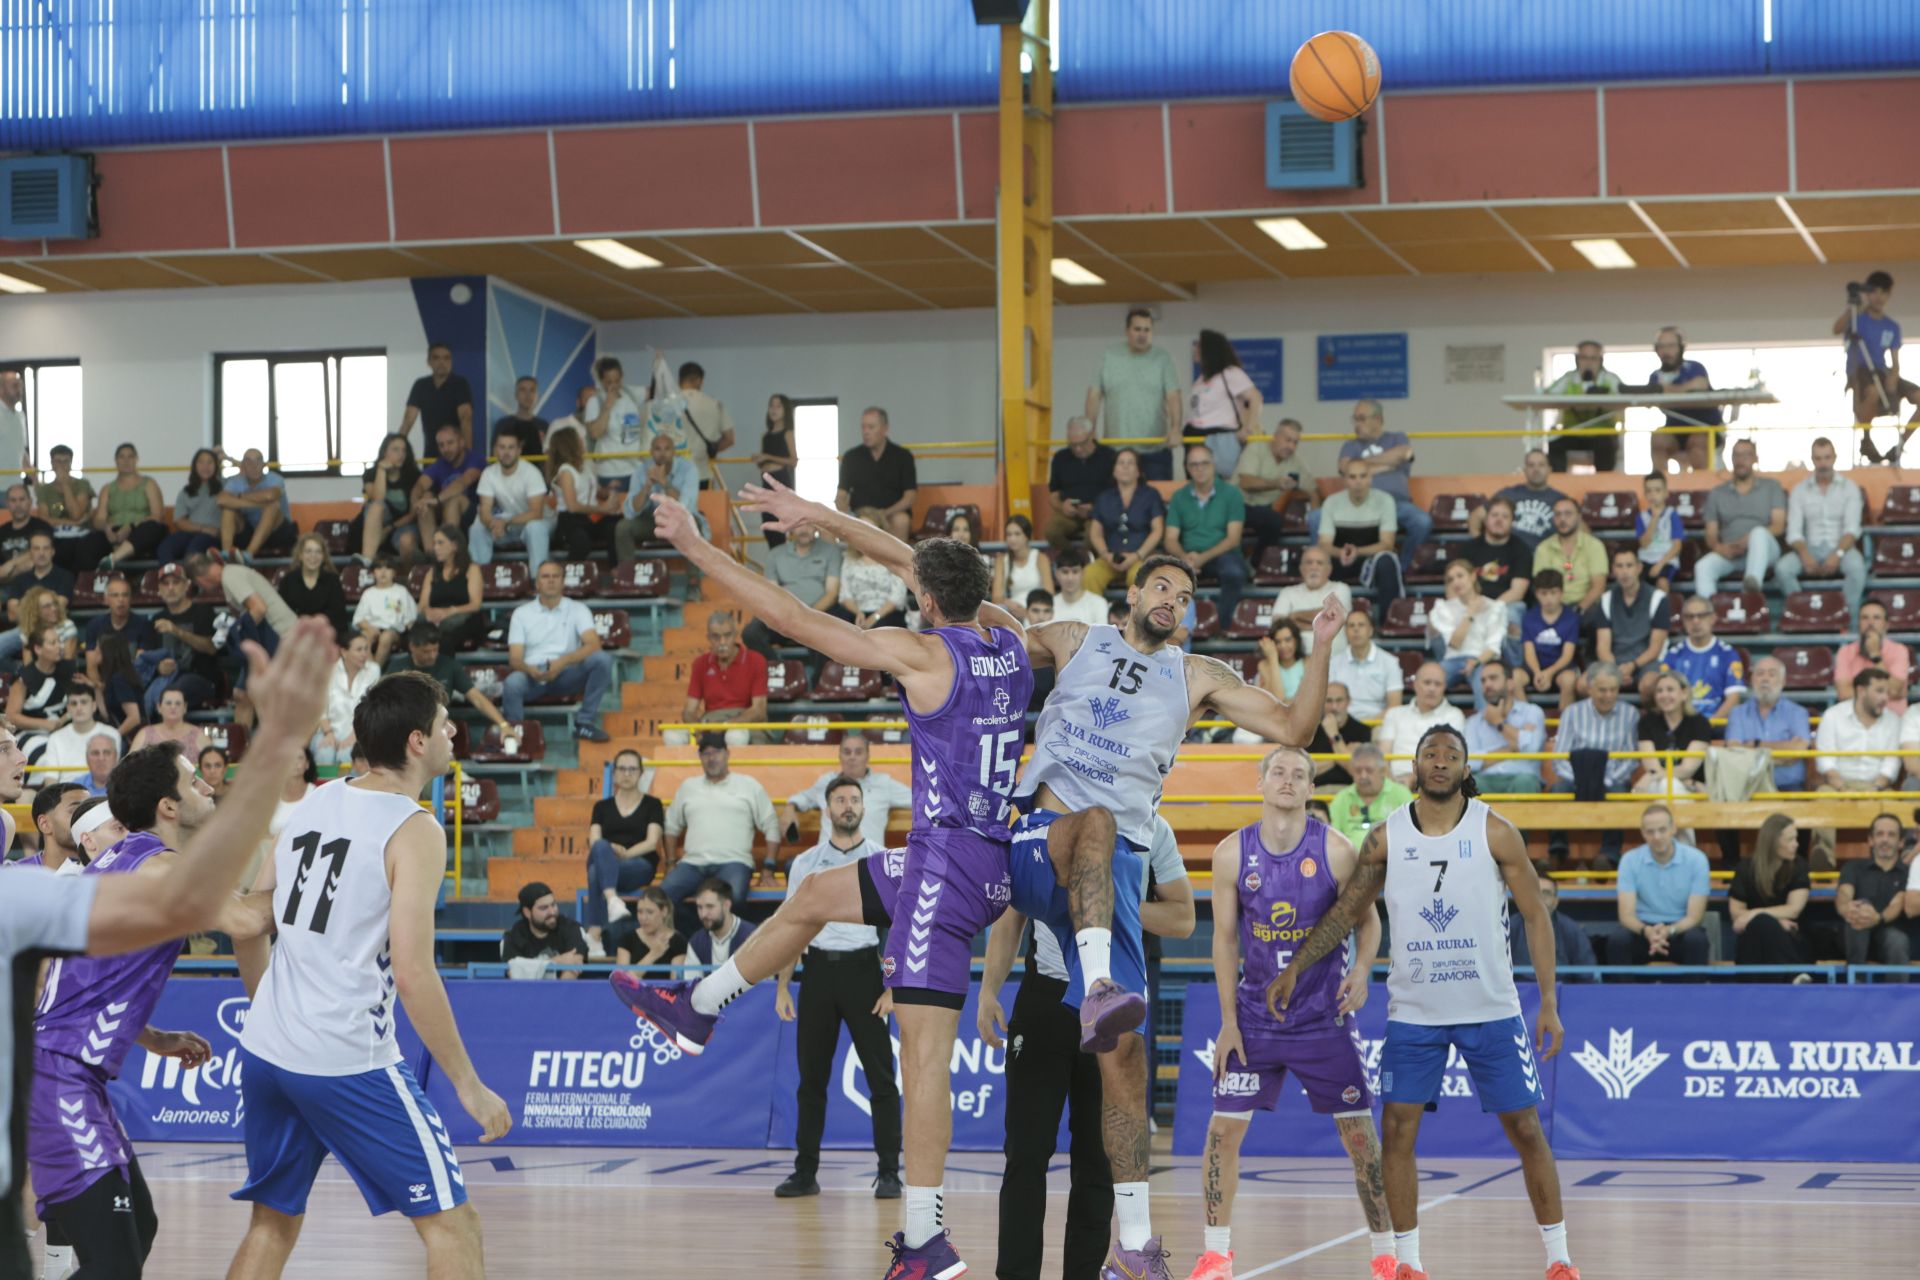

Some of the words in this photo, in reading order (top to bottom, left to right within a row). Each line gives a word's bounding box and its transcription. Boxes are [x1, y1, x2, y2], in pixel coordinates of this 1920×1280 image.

[1108, 657, 1148, 695] 15
[972, 715, 1009, 726] recoleto
[1088, 732, 1131, 759] RURAL
[979, 729, 1019, 797] 15
[1063, 756, 1115, 786] ZAMORA
[282, 830, 352, 935] 11
[1430, 860, 1448, 893] 7
[1253, 926, 1314, 943] agropa
[1406, 940, 1433, 952] CAJA
[1437, 938, 1477, 950] RURAL
[1430, 969, 1480, 983] ZAMORA
[1683, 1039, 1781, 1073] CAJA
[1789, 1041, 1920, 1072] RURAL
[529, 1050, 647, 1089] FITECU
[525, 1092, 550, 1105] FERIA
[551, 1092, 617, 1106] INTERNACIONAL
[619, 1093, 632, 1105] DE
[1684, 1076, 1725, 1098] DE
[1735, 1076, 1861, 1099] ZAMORA
[152, 1107, 230, 1124] Jamones
[231, 1111, 244, 1128] y
[524, 1102, 583, 1117] INNOVACIÓN
[584, 1105, 592, 1117] Y
[592, 1103, 652, 1118] TECNOLOGÍA
[522, 1116, 533, 1128] AL
[535, 1116, 573, 1129] SERVICIO
[574, 1117, 585, 1129] DE
[586, 1117, 603, 1129] LOS
[604, 1117, 648, 1130] CUIDADOS
